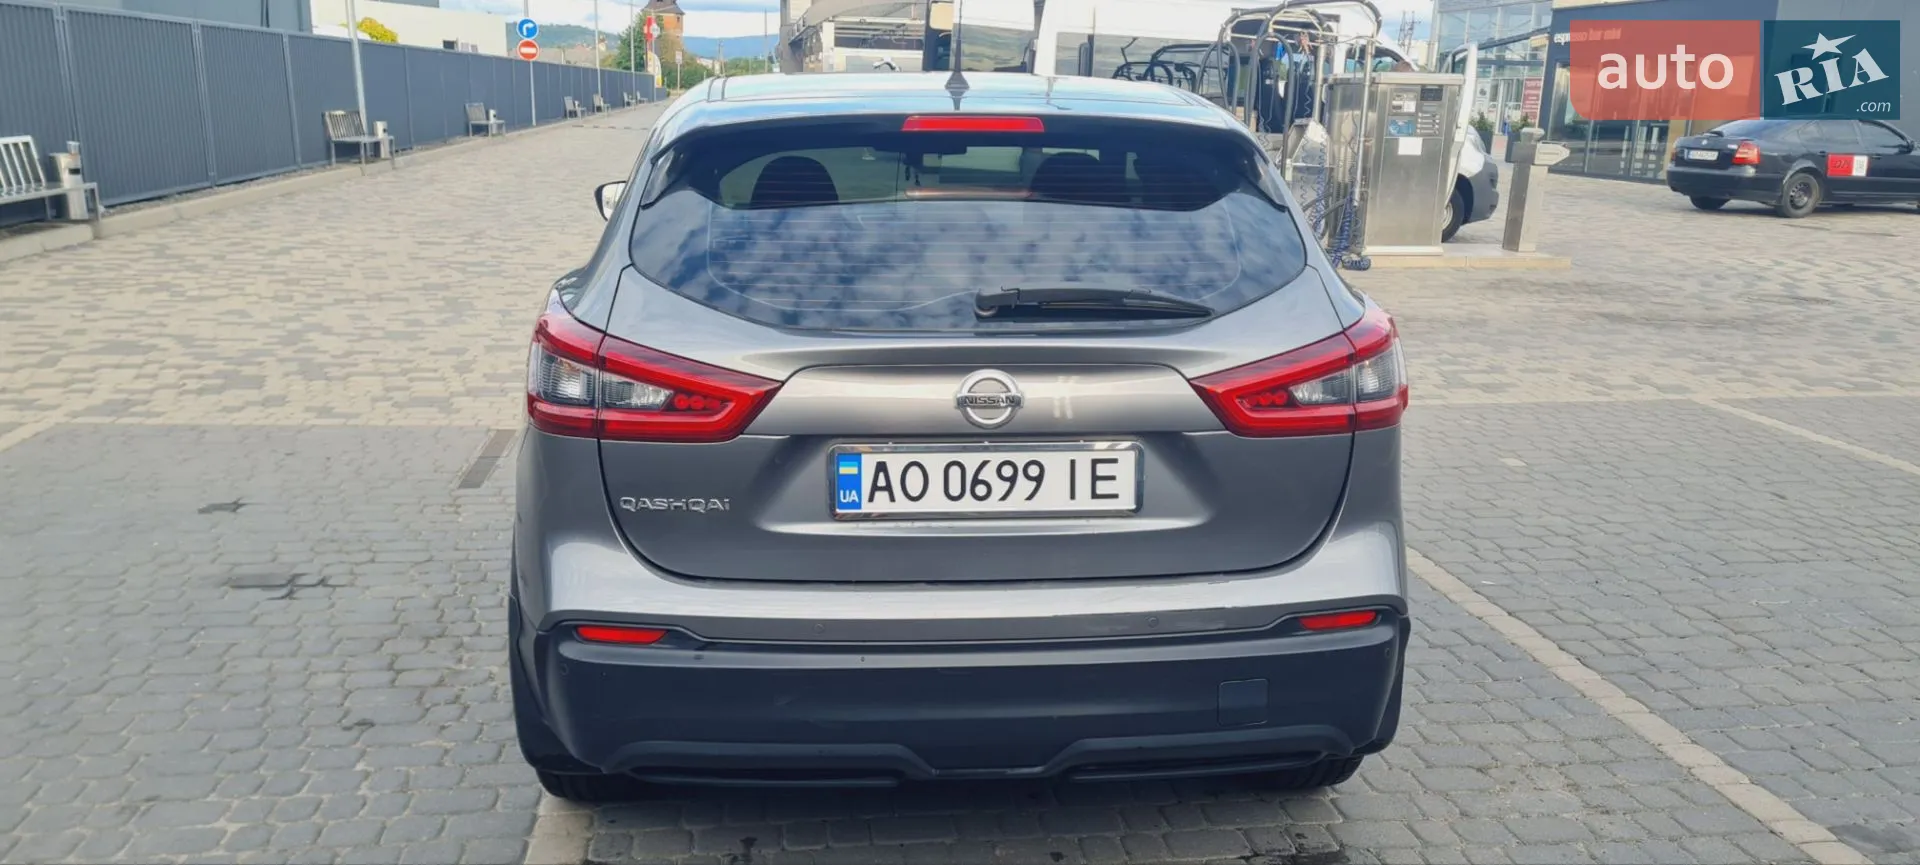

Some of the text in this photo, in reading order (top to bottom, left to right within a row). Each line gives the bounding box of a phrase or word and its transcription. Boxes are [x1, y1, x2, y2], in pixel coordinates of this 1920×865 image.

[963, 395, 1015, 405] NISSAN
[868, 458, 1120, 503] AO 0699 IE
[839, 490, 859, 503] UA
